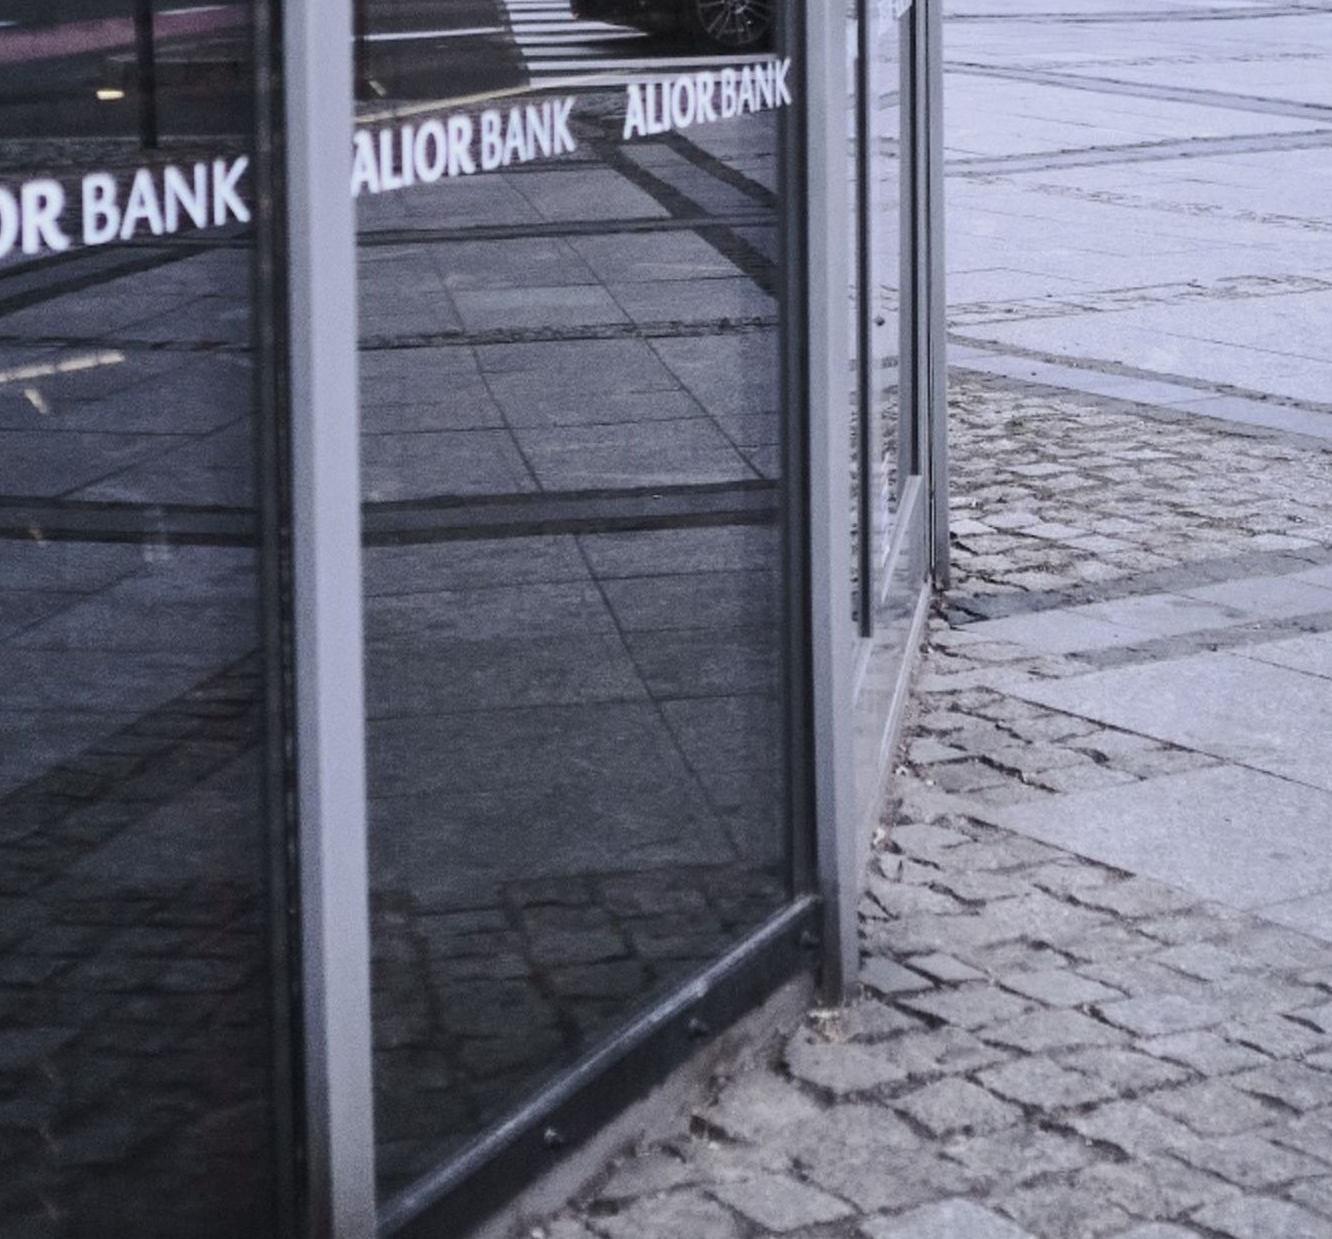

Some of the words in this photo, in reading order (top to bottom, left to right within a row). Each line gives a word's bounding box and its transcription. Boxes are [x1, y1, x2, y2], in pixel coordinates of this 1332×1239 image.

[623, 69, 716, 140] ALIOR
[720, 58, 792, 119] BANK
[351, 114, 476, 197] ALIOR
[479, 97, 577, 170] BANK
[82, 154, 252, 246] BANK
